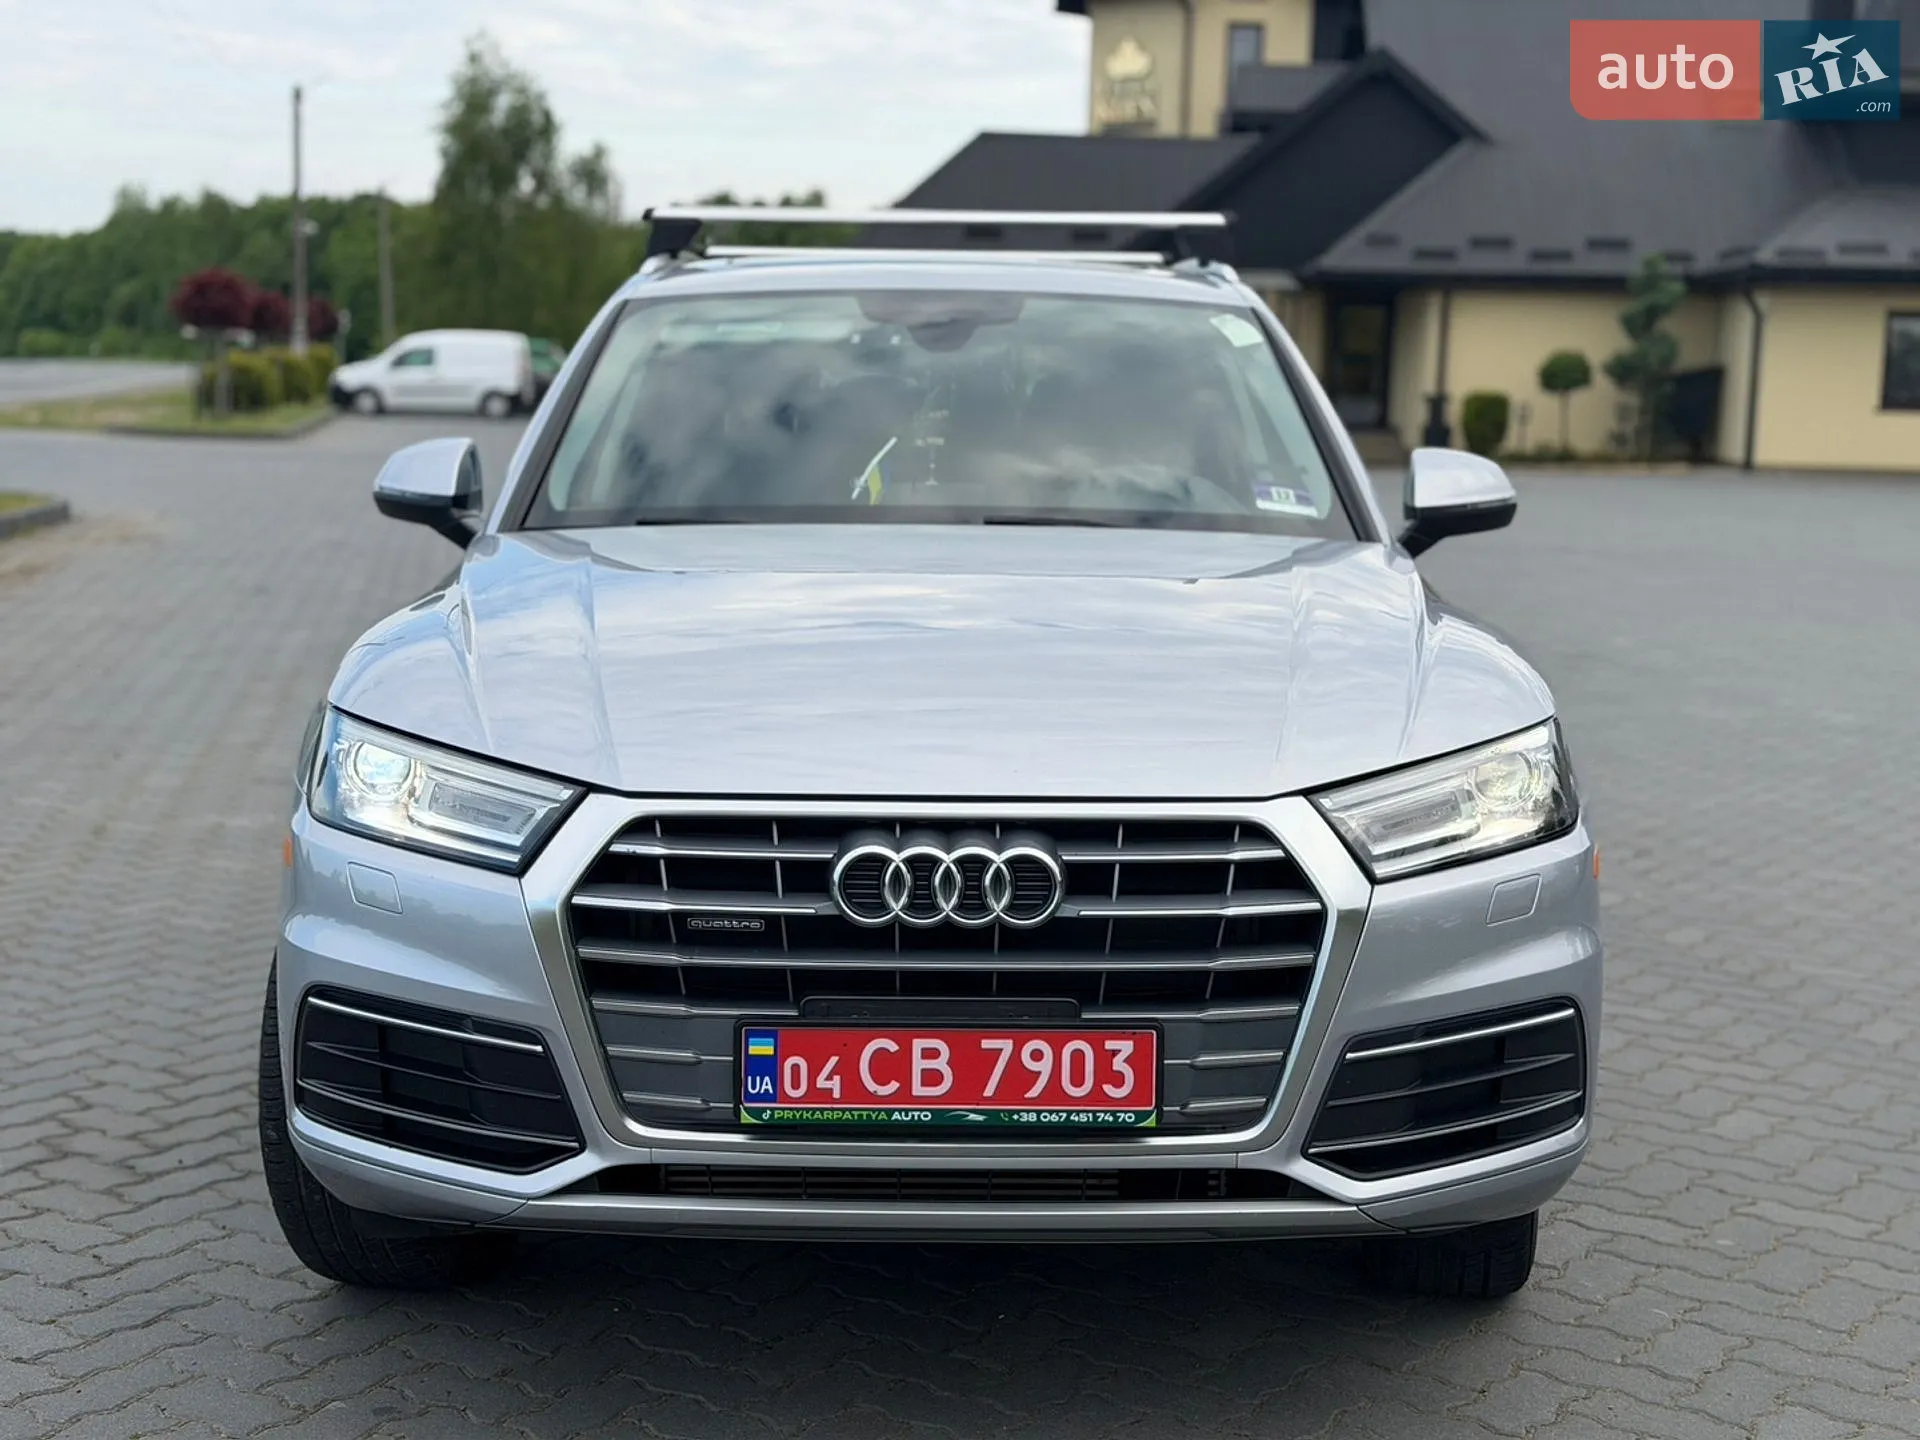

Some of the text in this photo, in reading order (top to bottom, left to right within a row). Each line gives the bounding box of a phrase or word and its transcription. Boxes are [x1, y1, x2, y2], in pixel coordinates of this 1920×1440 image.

[691, 920, 761, 929] quattro
[783, 1038, 1135, 1099] 04 CB 7903
[747, 1076, 773, 1094] UA
[774, 1110, 932, 1121] PRYKARPATTYA AUTO
[1012, 1112, 1136, 1122] +38 067 451 74 70
